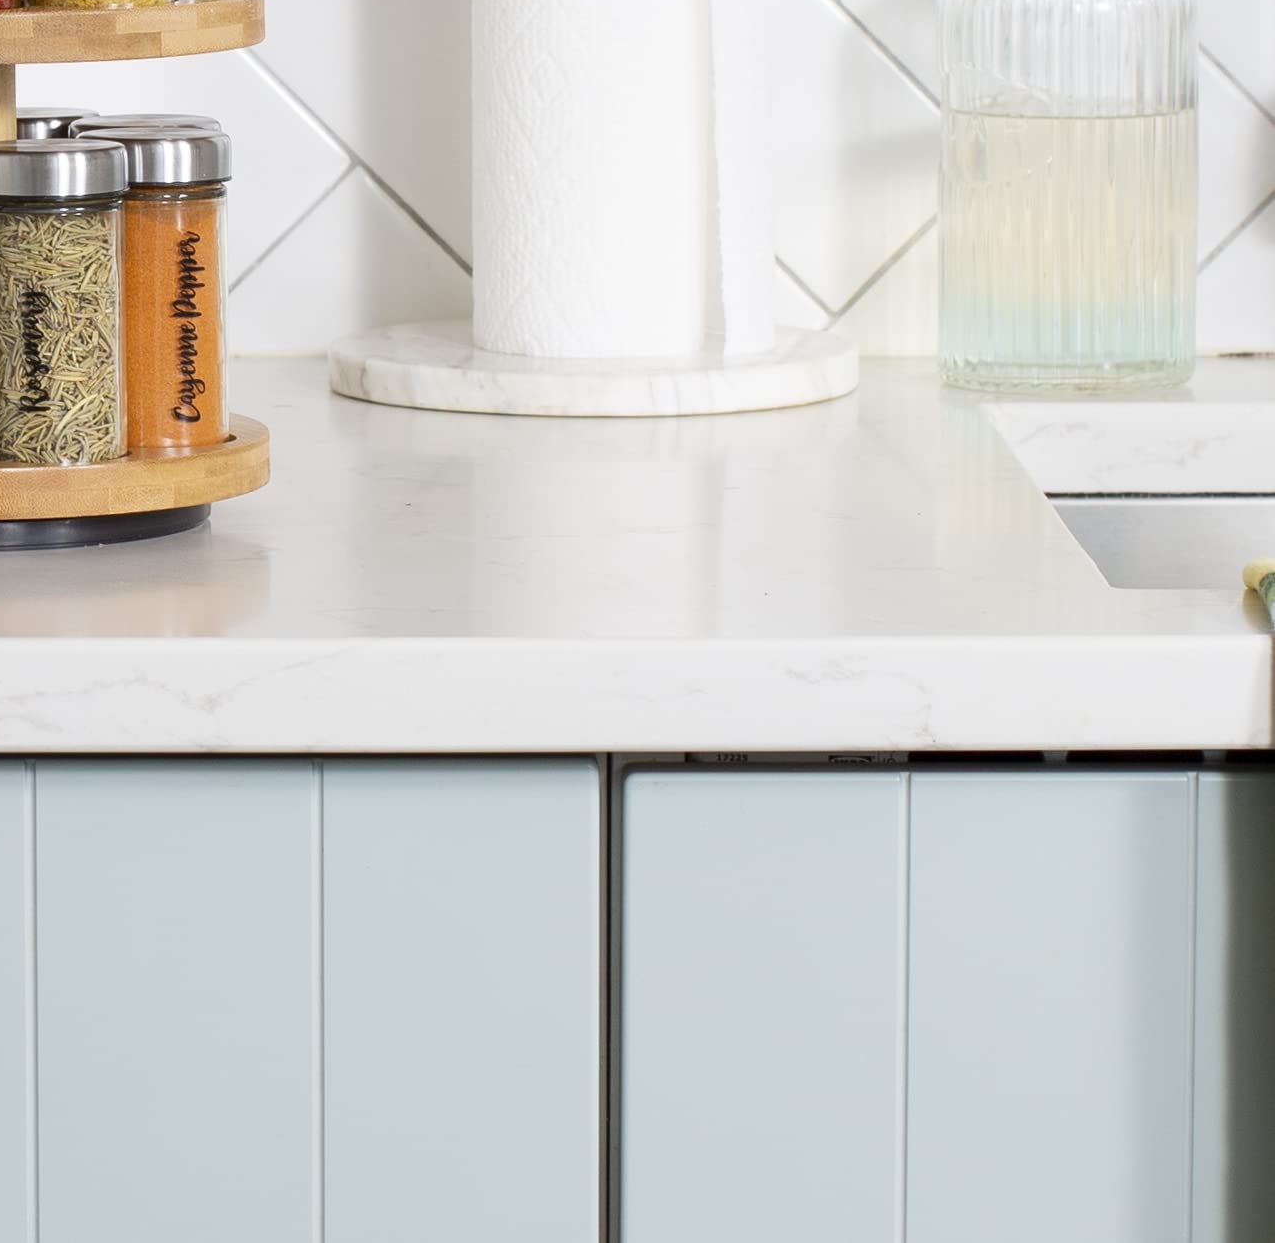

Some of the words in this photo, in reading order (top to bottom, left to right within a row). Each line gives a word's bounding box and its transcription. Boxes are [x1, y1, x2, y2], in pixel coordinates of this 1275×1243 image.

[170, 230, 206, 319] Pepper
[19, 286, 52, 413] Rosemary
[172, 321, 206, 423] Cayenne
